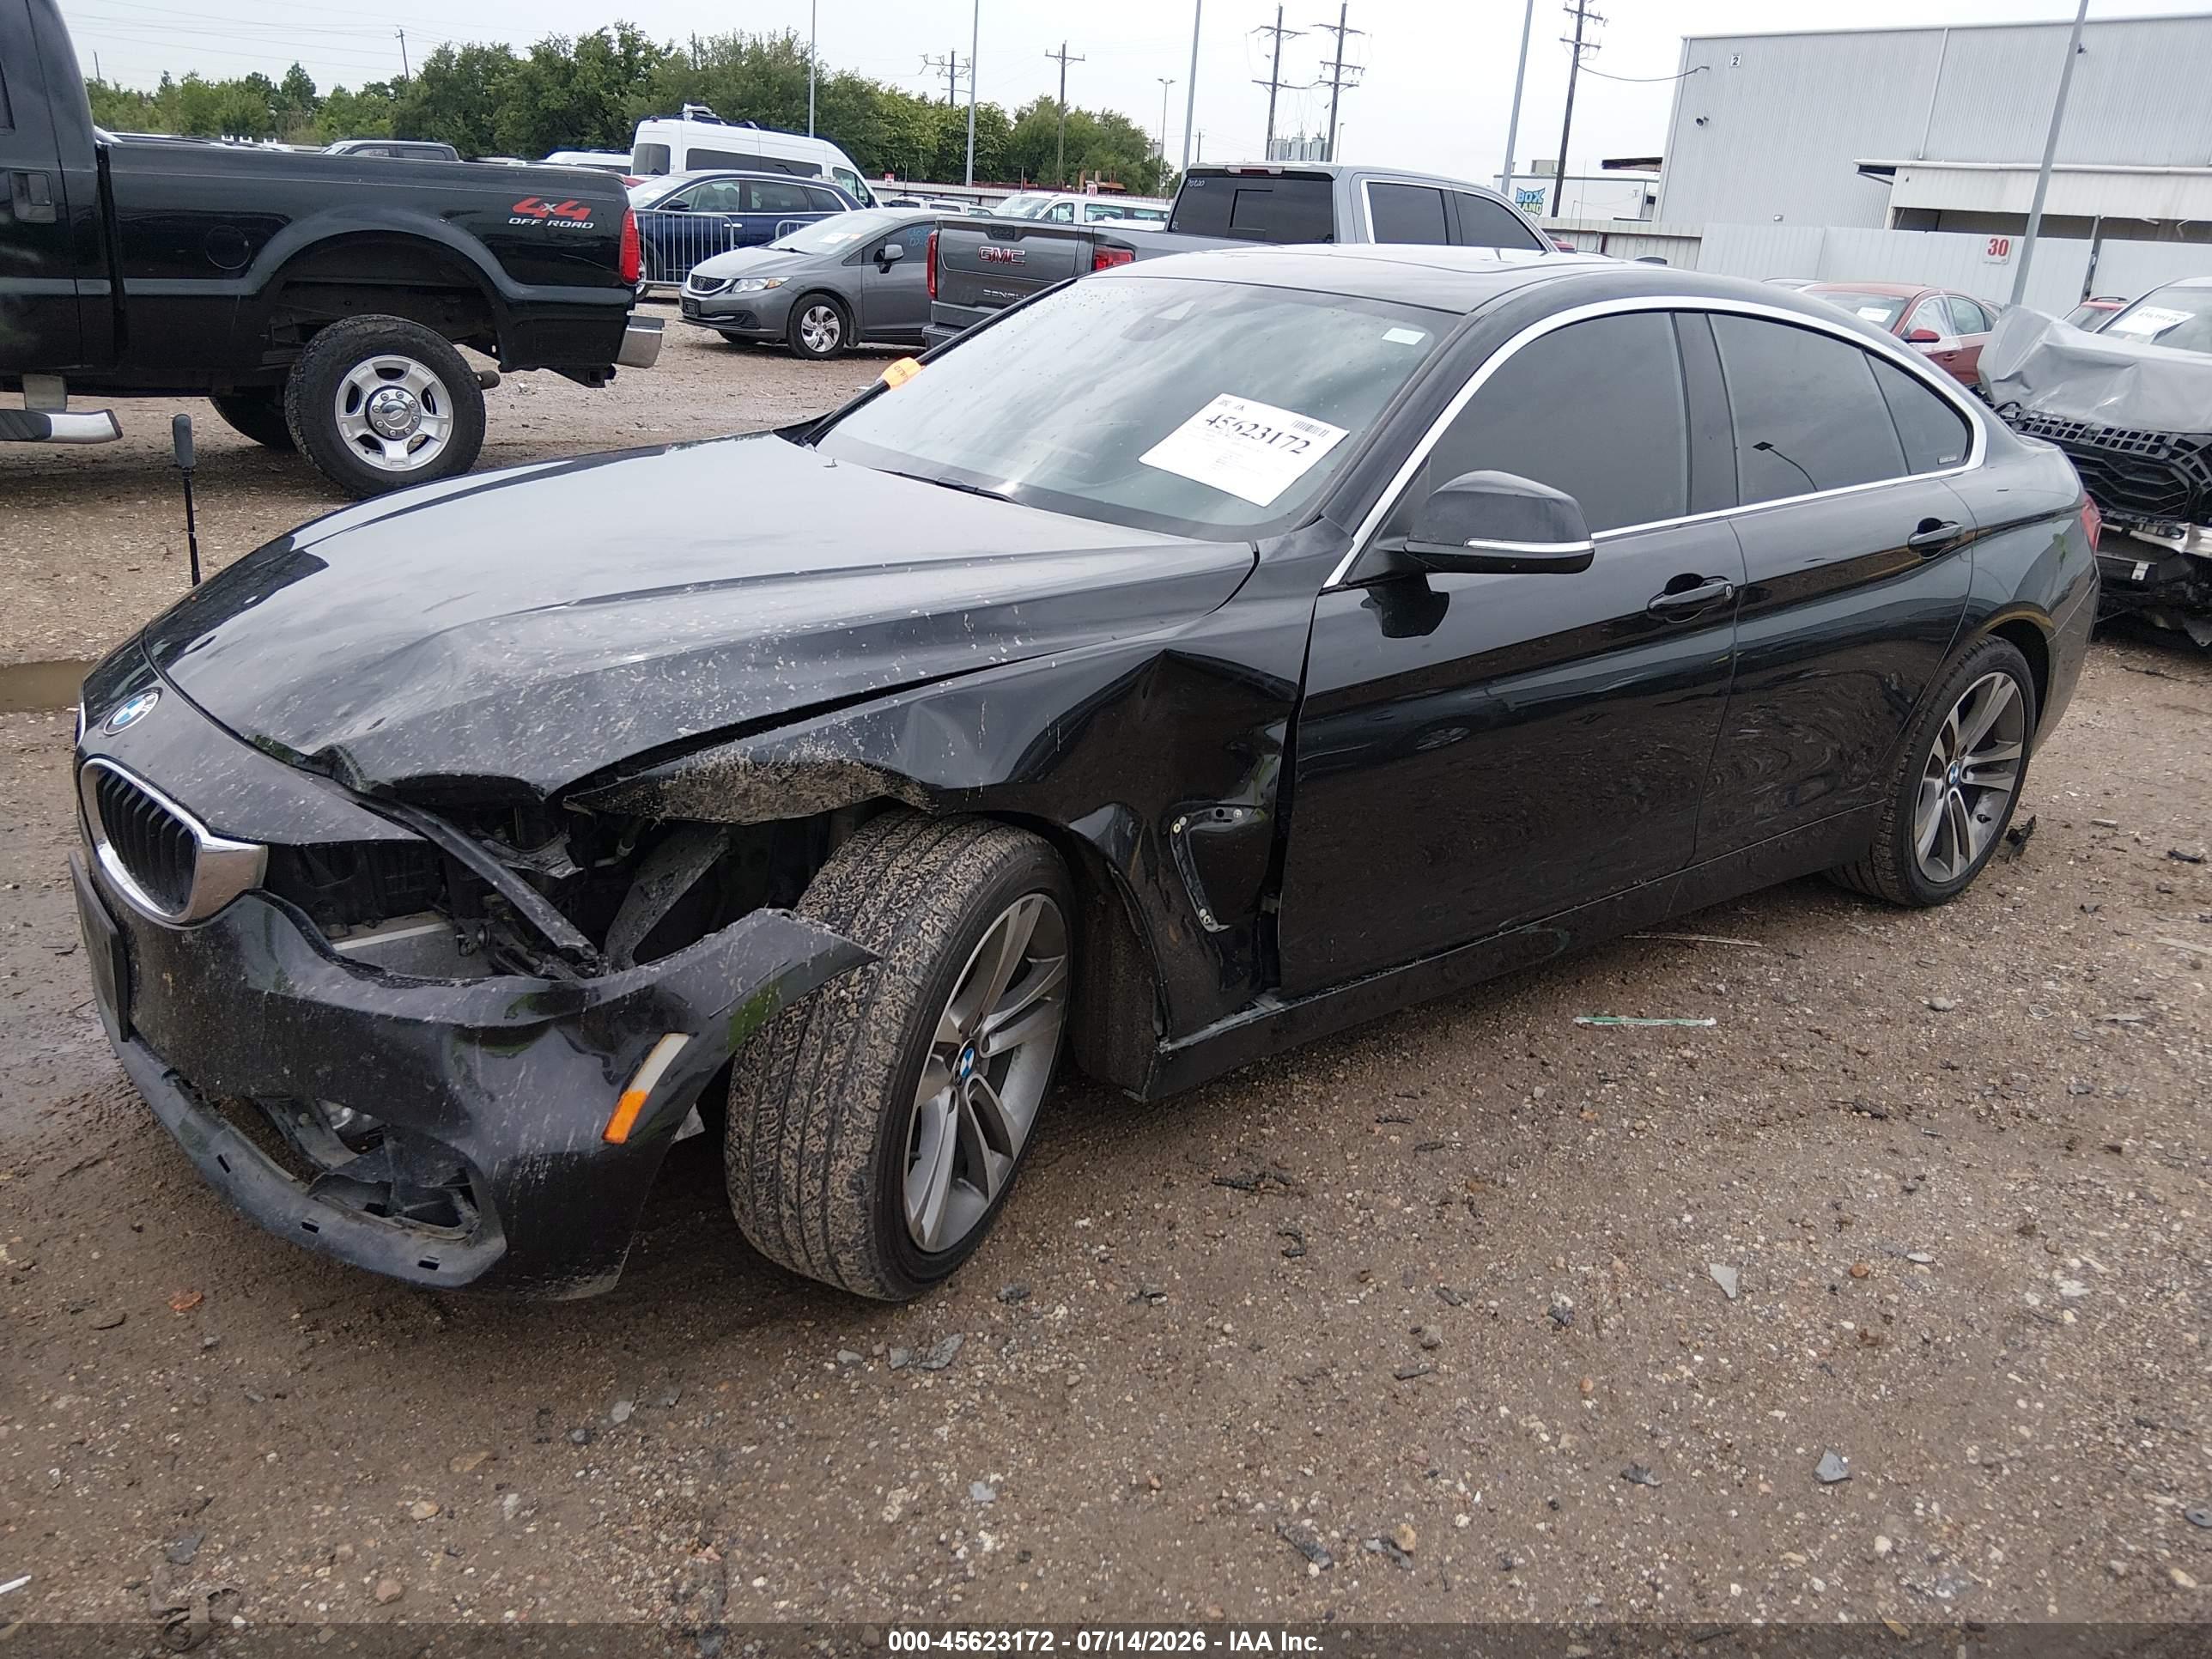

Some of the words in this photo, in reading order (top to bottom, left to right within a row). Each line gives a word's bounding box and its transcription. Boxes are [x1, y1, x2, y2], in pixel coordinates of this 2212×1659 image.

[1732, 56, 1739, 66] 2
[1516, 187, 1546, 204] BOX
[508, 216, 543, 226] OFF
[547, 219, 595, 230] ROAD
[978, 246, 1026, 266] GMC
[1987, 238, 2009, 257] 30
[1206, 413, 1311, 454] 45623172
